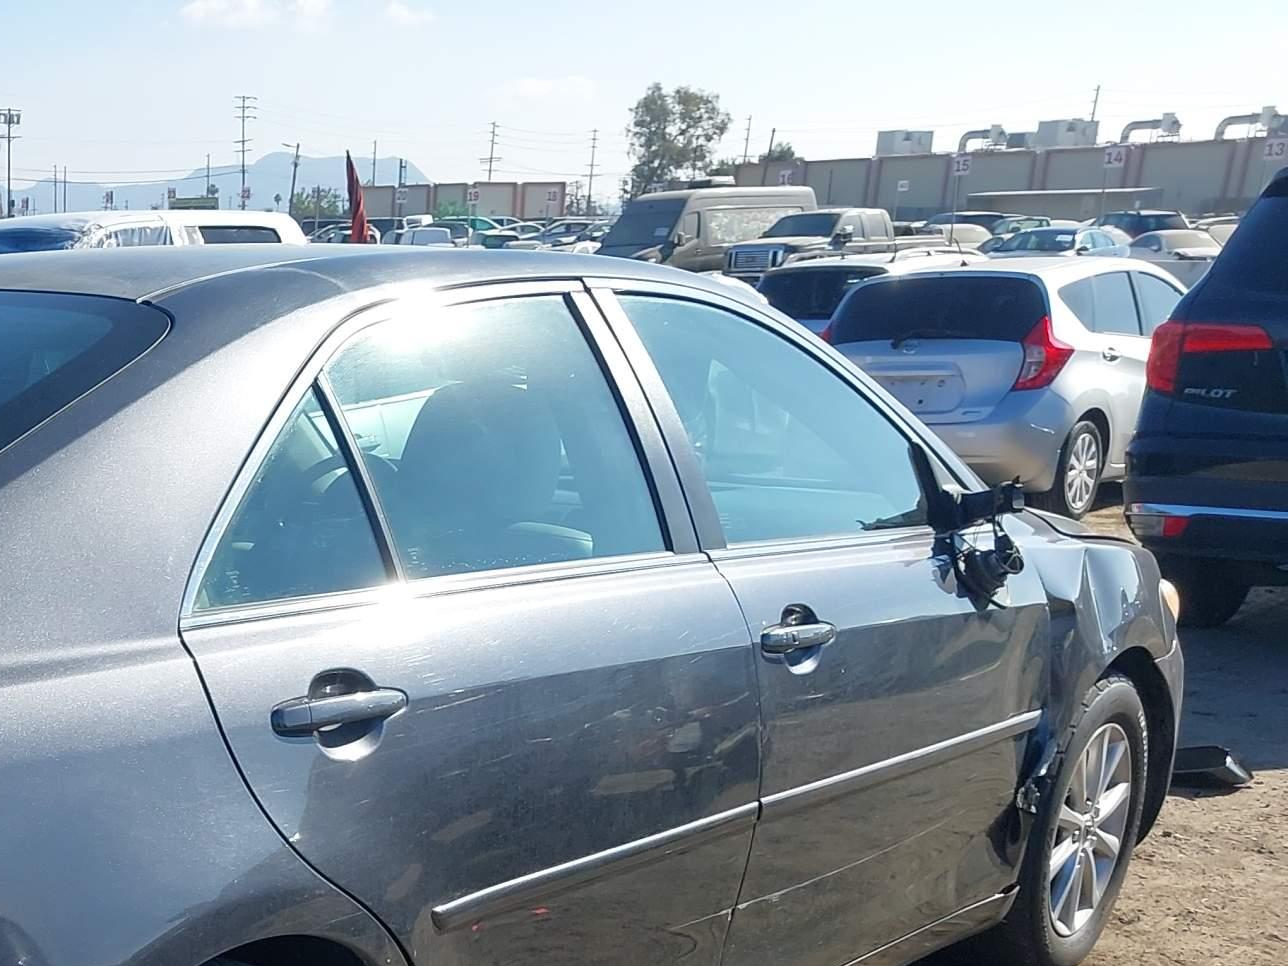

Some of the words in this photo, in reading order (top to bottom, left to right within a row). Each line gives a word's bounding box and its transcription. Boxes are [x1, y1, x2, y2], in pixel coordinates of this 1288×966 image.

[1265, 142, 1285, 157] 13
[1104, 151, 1123, 165] 14
[955, 159, 969, 173] 15
[469, 191, 480, 201] 19
[1184, 387, 1238, 398] PILOT
